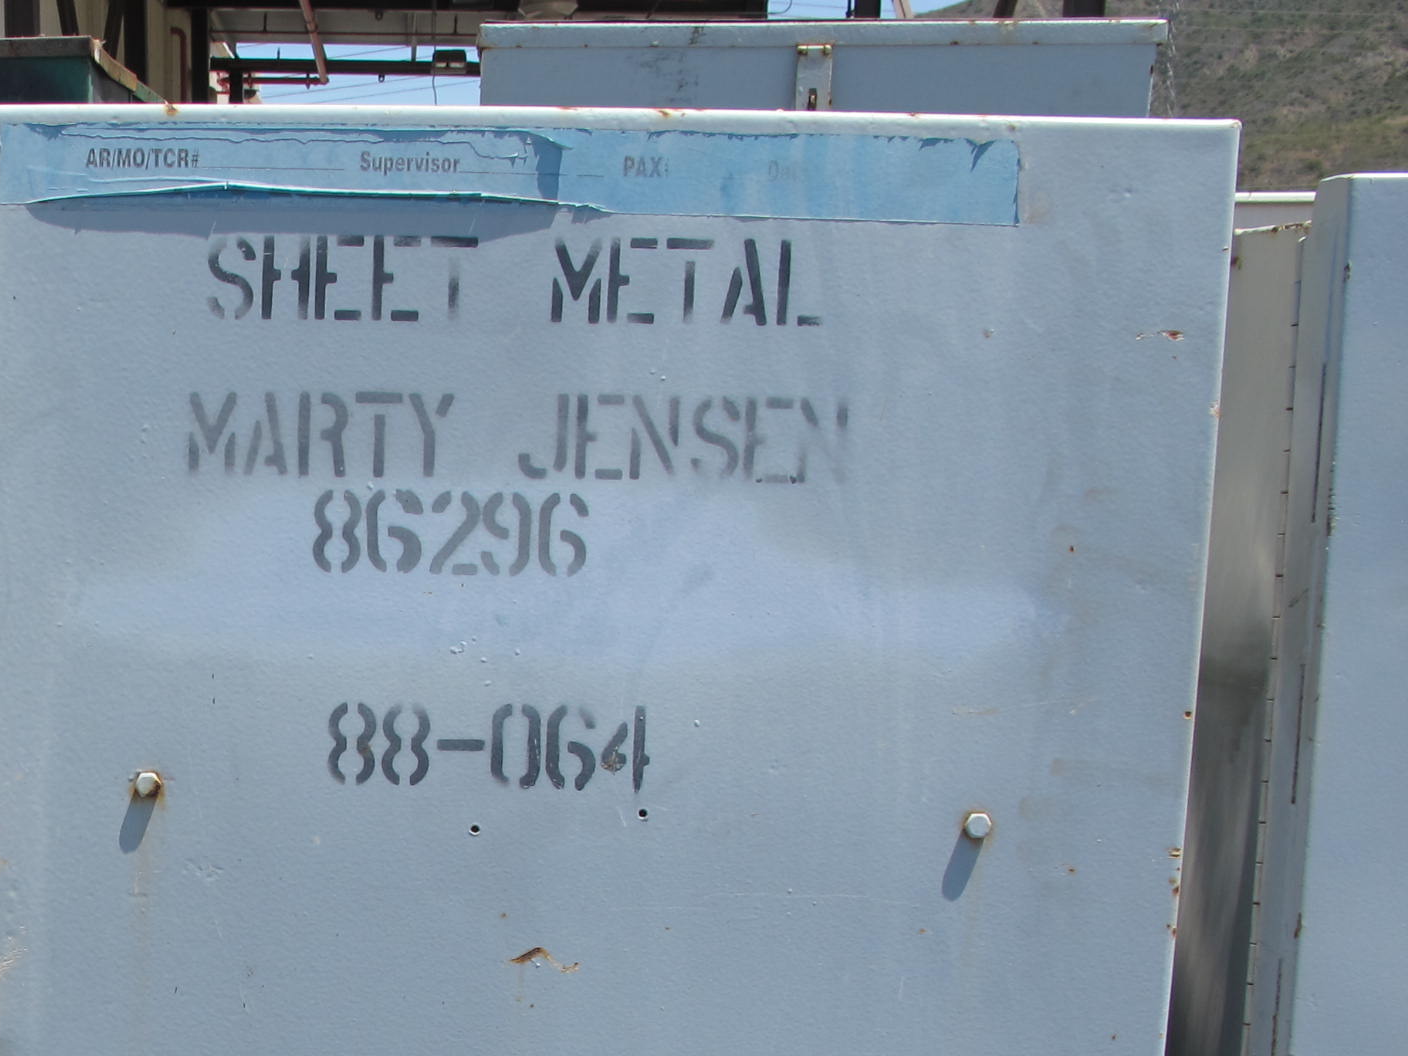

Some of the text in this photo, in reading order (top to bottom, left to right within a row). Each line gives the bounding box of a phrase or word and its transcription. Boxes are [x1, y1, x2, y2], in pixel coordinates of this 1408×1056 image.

[86, 147, 200, 170] AR/MO/TCR#
[360, 150, 460, 176] Supervisor
[206, 234, 823, 327] SHEET METAL
[188, 391, 849, 484] MARTY JENSEN
[311, 488, 590, 577] 86296
[327, 701, 651, 794] 88-064
